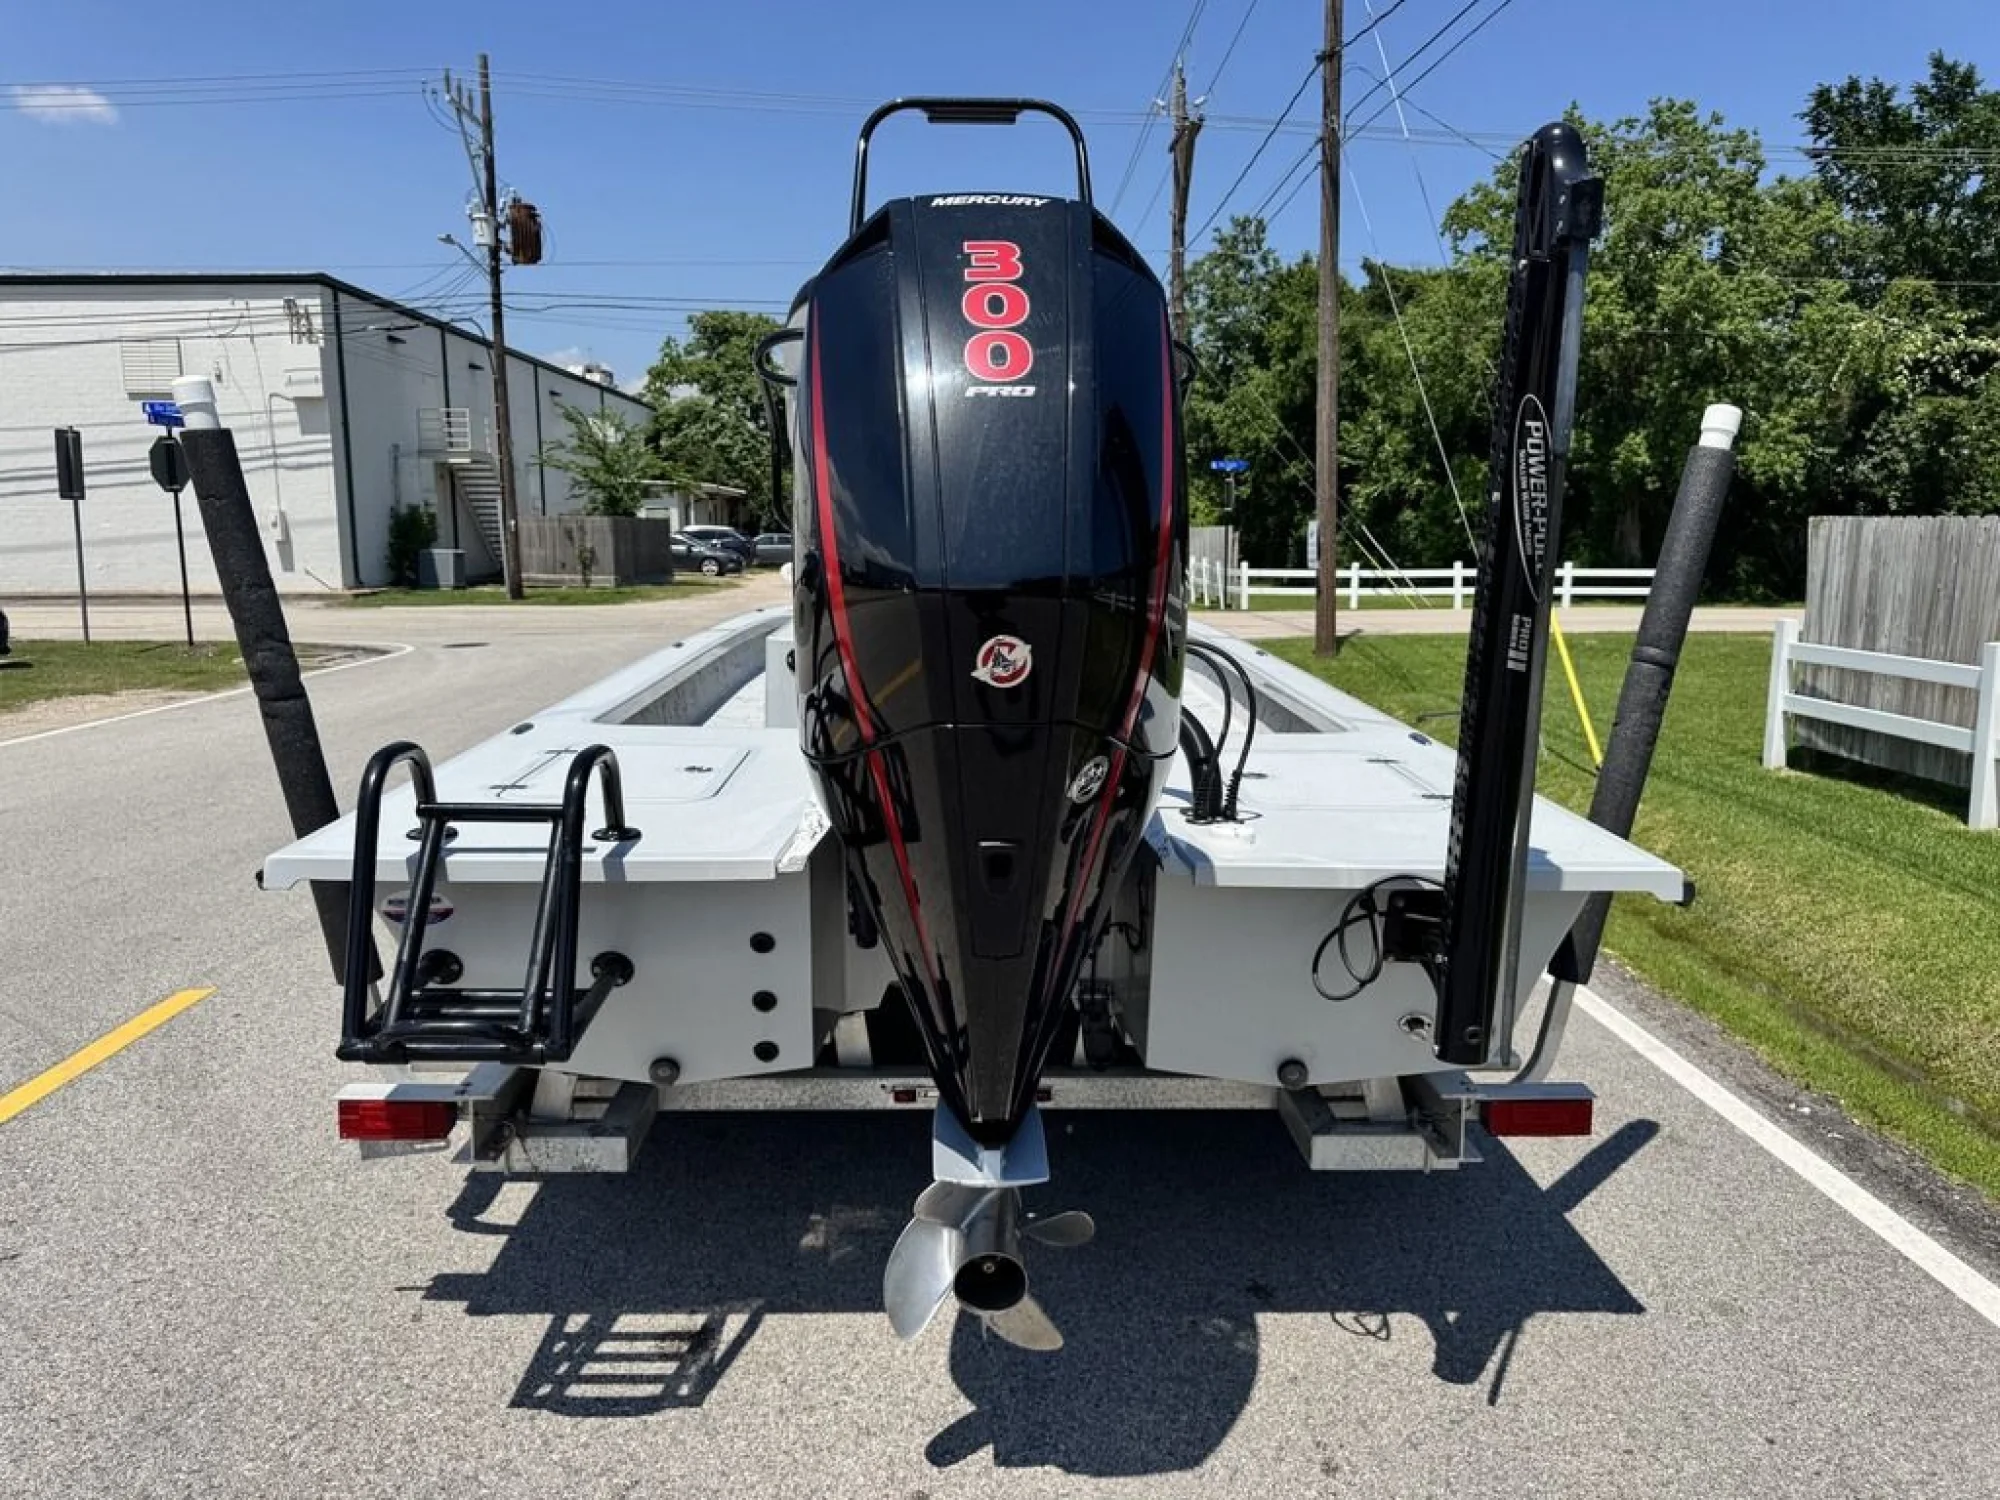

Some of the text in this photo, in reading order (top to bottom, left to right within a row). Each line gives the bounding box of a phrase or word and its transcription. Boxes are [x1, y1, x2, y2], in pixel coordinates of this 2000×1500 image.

[931, 194, 1051, 207] MERCURY
[962, 240, 1033, 382] 300
[964, 386, 1036, 398] PRO
